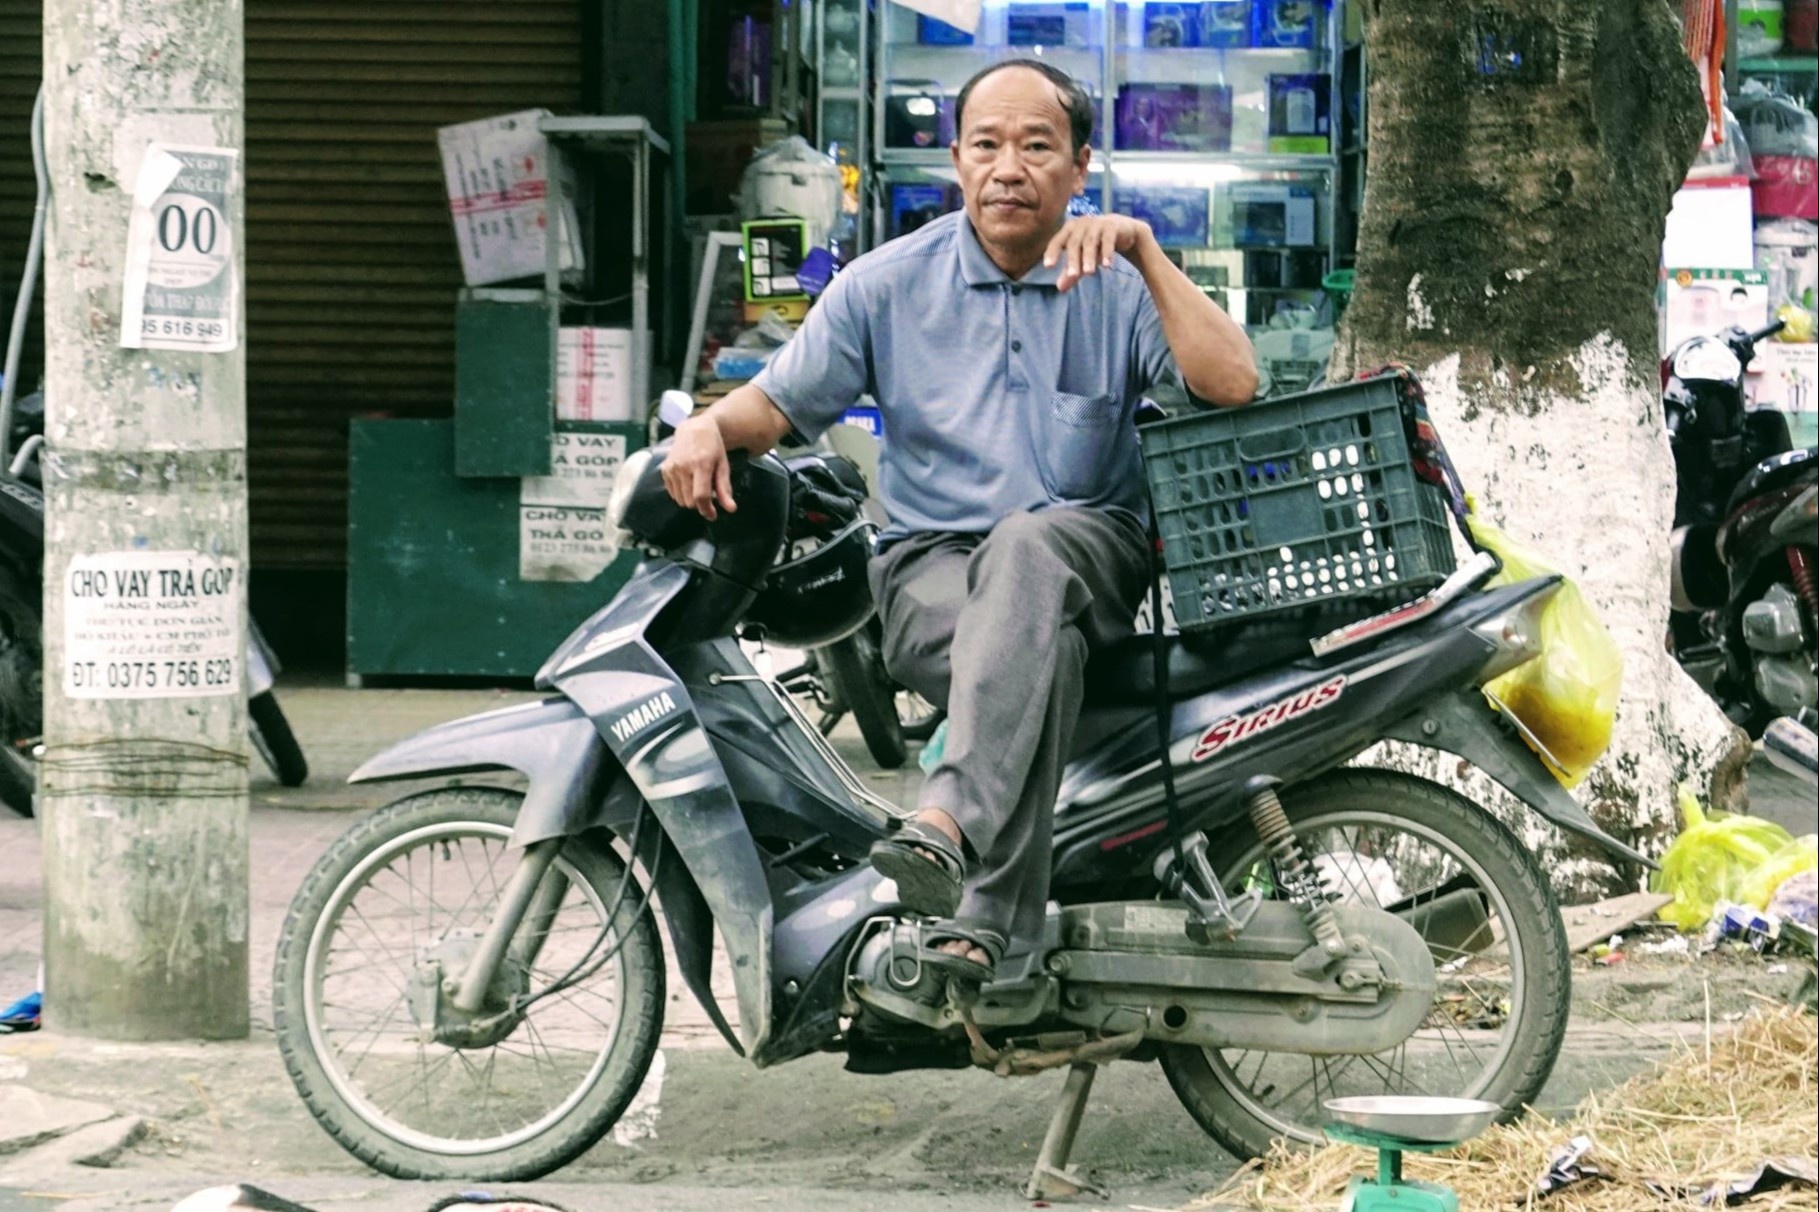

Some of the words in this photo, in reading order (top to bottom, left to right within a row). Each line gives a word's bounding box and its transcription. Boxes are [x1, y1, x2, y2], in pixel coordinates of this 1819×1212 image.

[163, 321, 192, 336] 616
[577, 437, 616, 447] VAY
[575, 511, 602, 521] VA
[71, 570, 108, 597] CHO
[115, 570, 151, 597] VAY
[107, 660, 156, 688] 0375
[164, 660, 199, 688] 756
[205, 658, 232, 686] 629
[610, 691, 677, 743] YAMAHA
